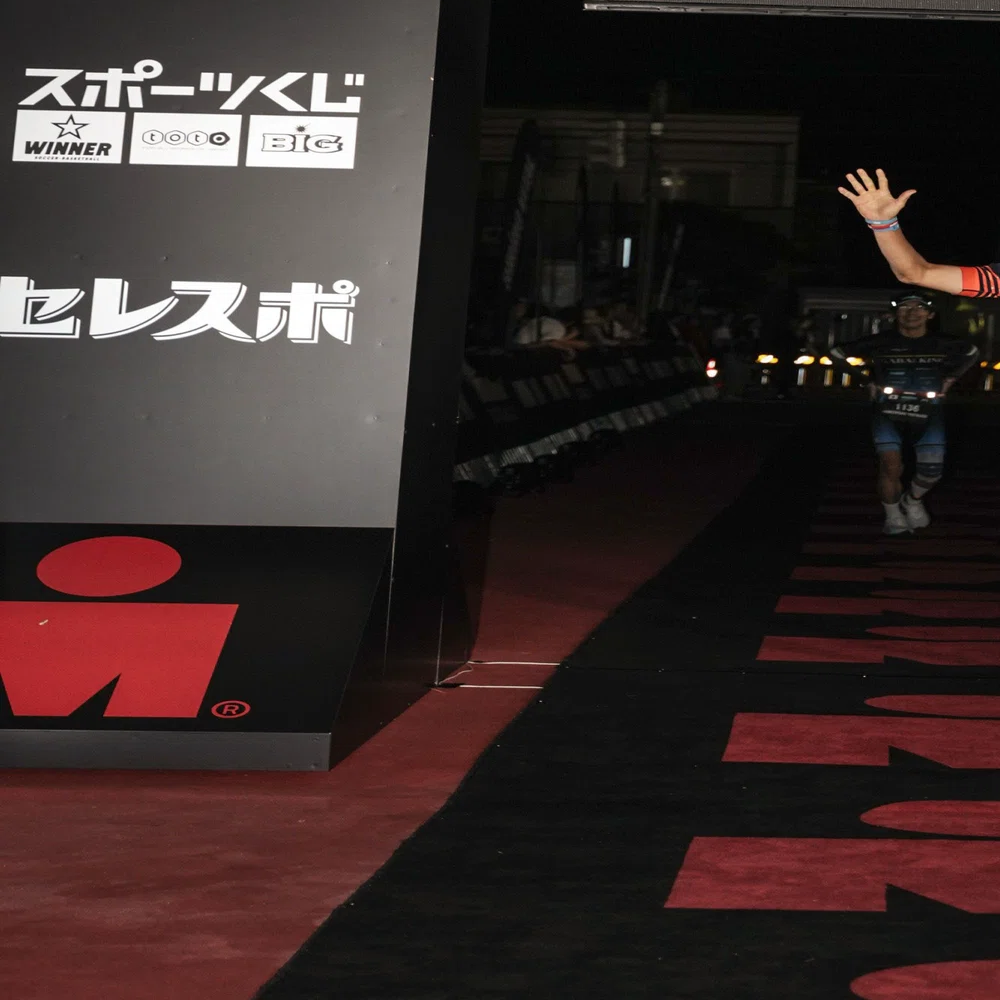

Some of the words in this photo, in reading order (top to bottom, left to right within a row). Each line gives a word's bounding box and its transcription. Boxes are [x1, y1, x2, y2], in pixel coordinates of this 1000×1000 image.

[17, 59, 365, 113] スポーツくじ
[25, 140, 112, 157] WINNER
[142, 129, 231, 146] toto
[261, 132, 344, 154] BIG
[0, 276, 360, 345] セレスポ
